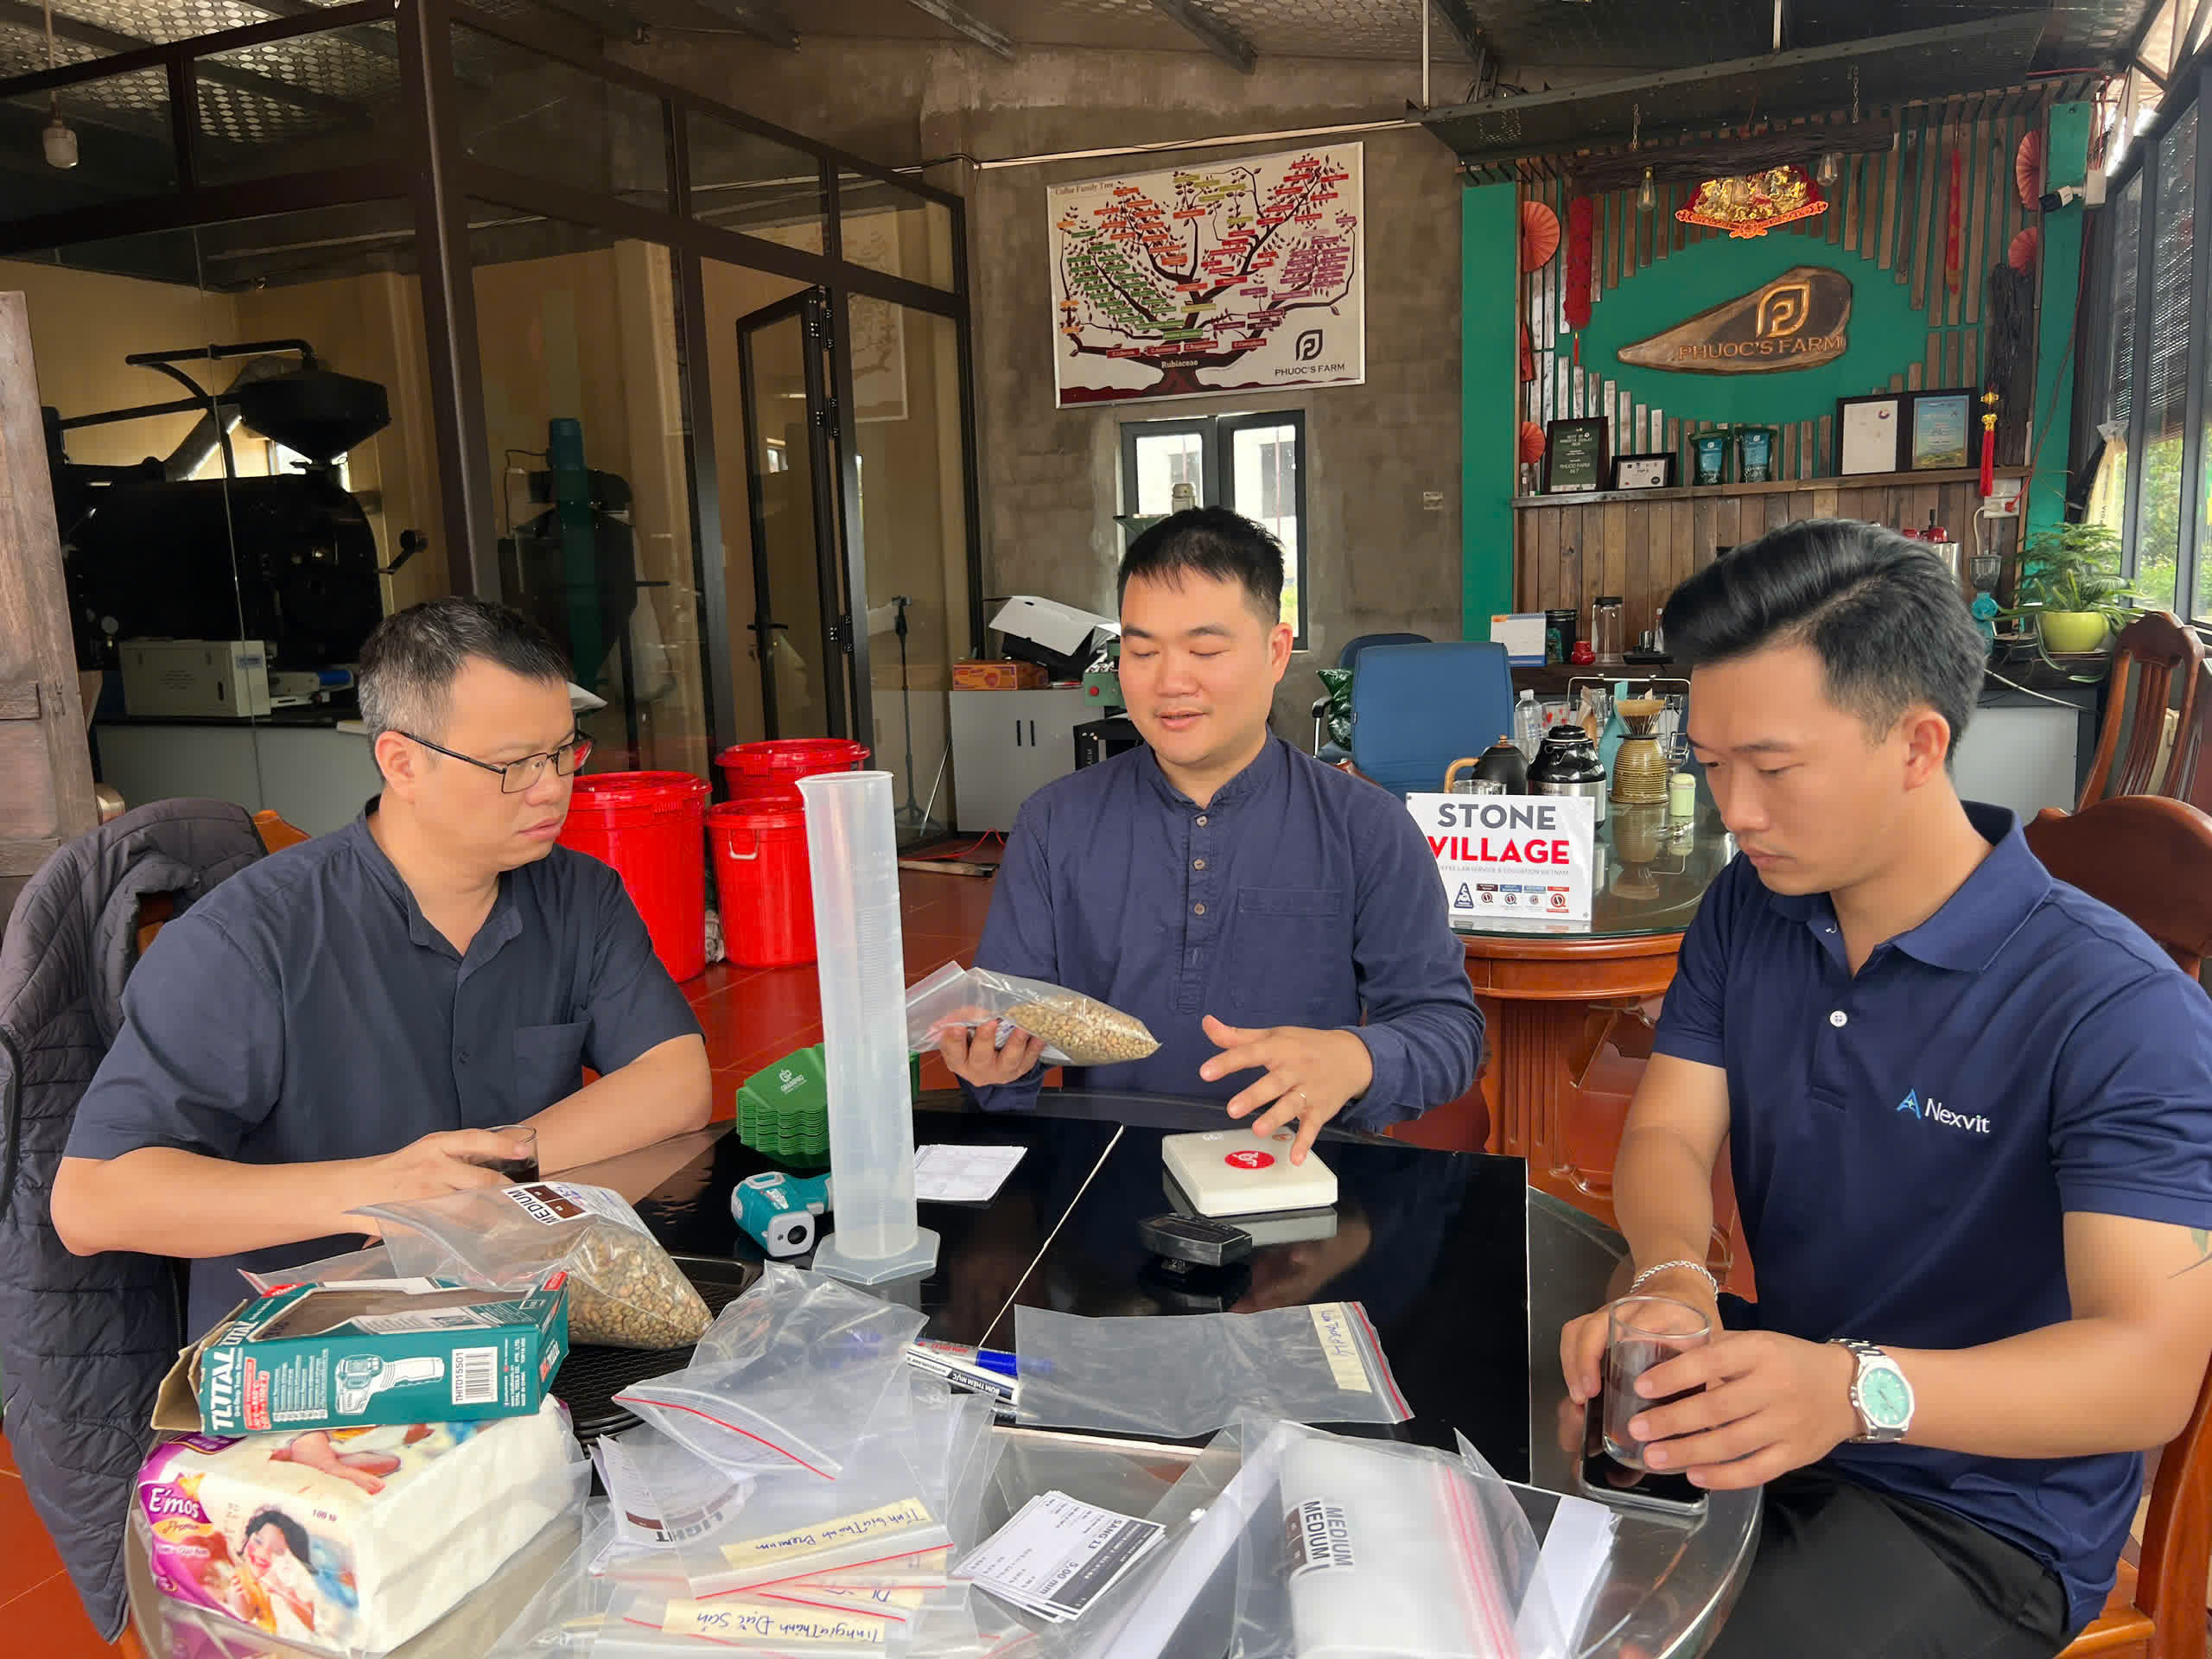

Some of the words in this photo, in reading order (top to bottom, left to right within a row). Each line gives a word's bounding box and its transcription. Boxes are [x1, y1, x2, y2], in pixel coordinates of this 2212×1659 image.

[1778, 336, 1842, 354] FARM
[1160, 359, 1198, 369] Rubiaceae
[1274, 365, 1316, 377] PHUOC'S
[1318, 363, 1345, 372] FARM
[1437, 803, 1556, 830] STONE
[1427, 836, 1570, 865] VILLAGE
[1924, 1097, 1991, 1134] Nexvit
[506, 1189, 561, 1224] MEDIUM
[210, 1347, 236, 1431] TOTAL
[455, 1351, 465, 1402] THIT015501
[1303, 1500, 1330, 1560] MEDIUM
[1325, 1506, 1354, 1566] MEDIUM
